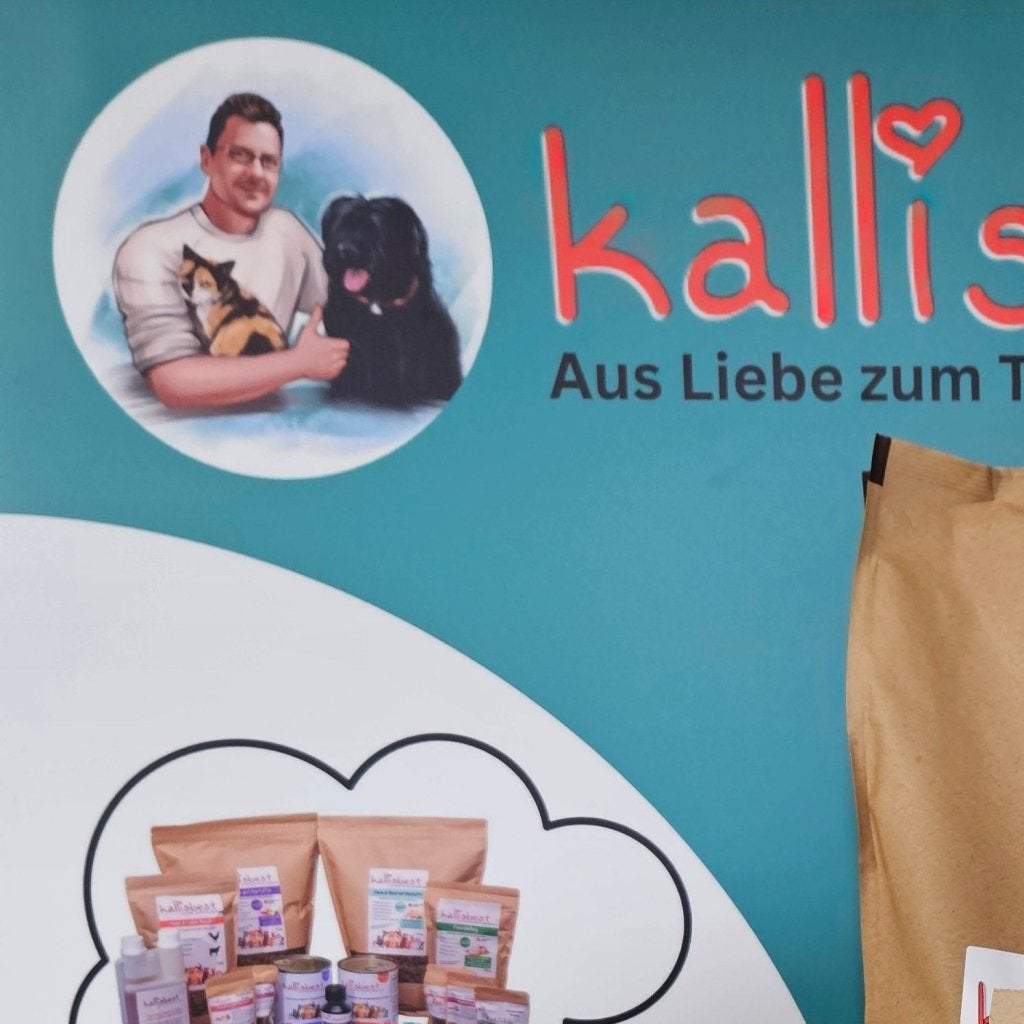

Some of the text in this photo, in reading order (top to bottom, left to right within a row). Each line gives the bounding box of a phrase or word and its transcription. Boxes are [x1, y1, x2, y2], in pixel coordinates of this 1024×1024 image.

[550, 352, 661, 401] Aus
[680, 352, 842, 401] Liebe
[859, 361, 981, 401] zum
